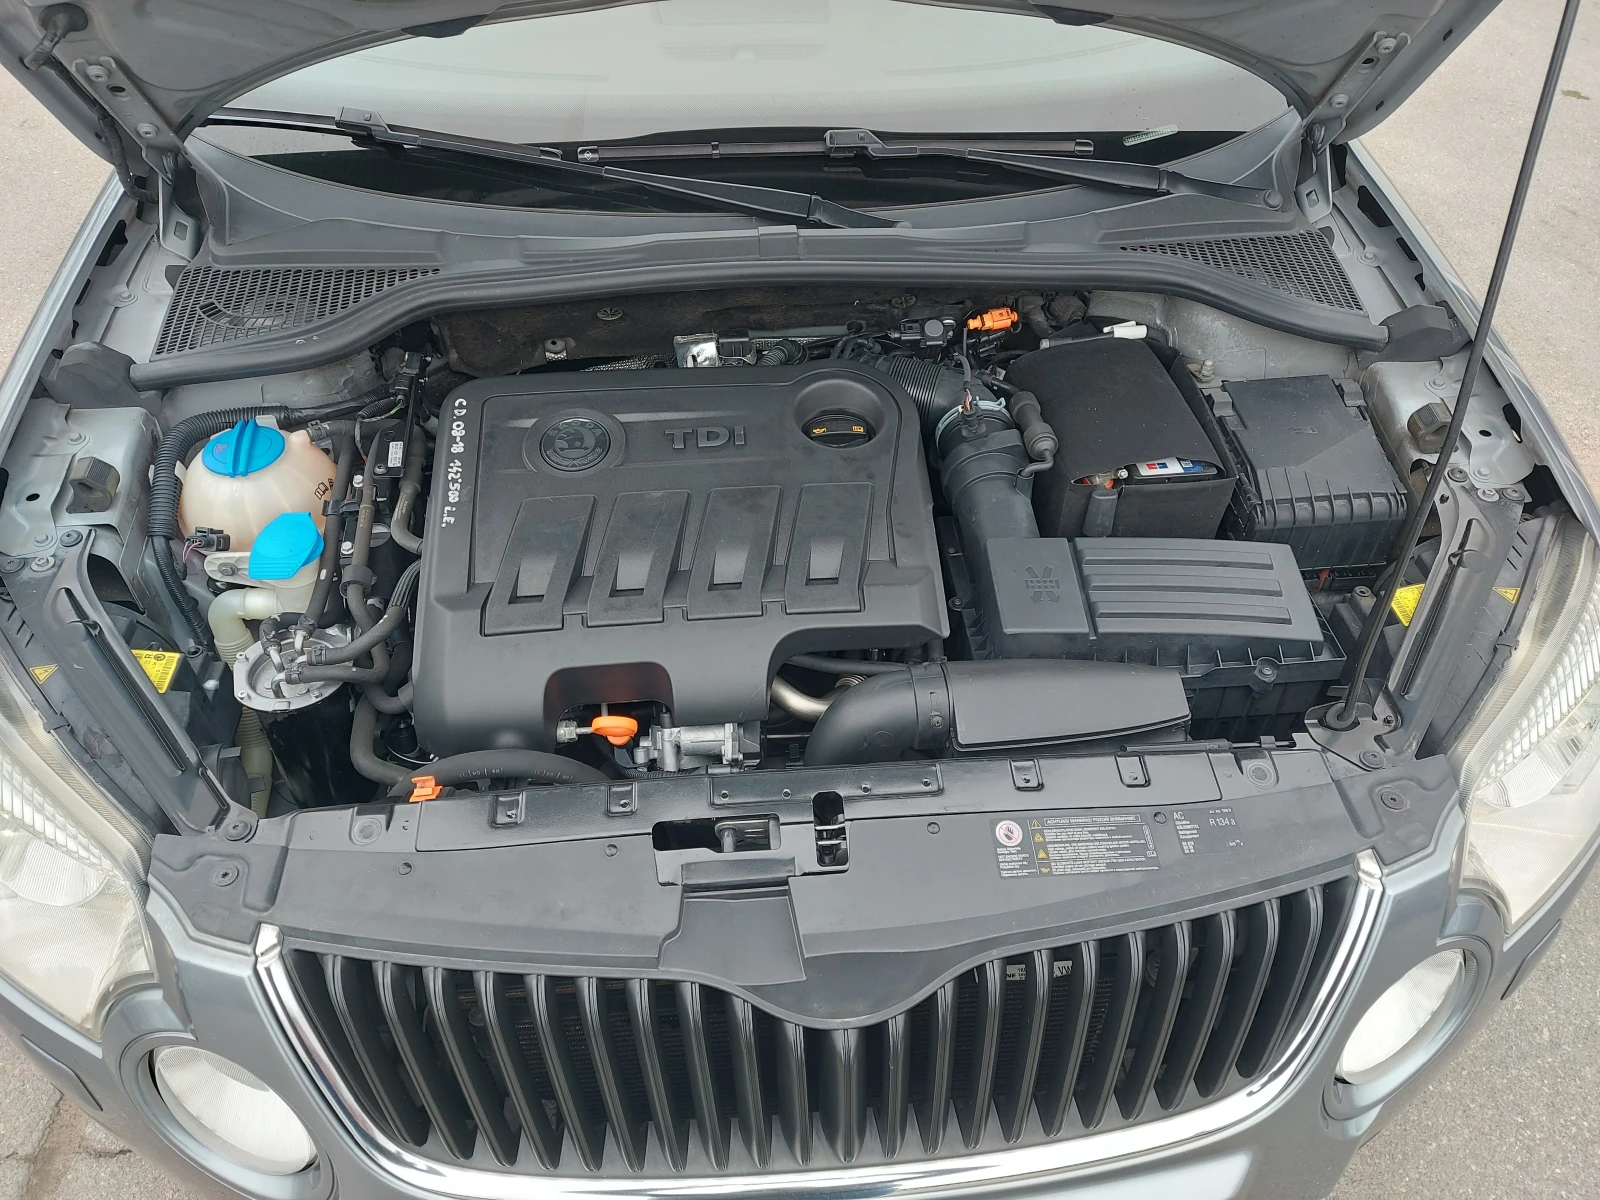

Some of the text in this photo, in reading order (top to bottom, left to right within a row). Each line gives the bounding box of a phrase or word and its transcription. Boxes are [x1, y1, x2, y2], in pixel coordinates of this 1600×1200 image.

[664, 425, 746, 450] TDI
[1173, 811, 1185, 820] AC
[1208, 817, 1217, 827] R
[1215, 817, 1230, 827] 134
